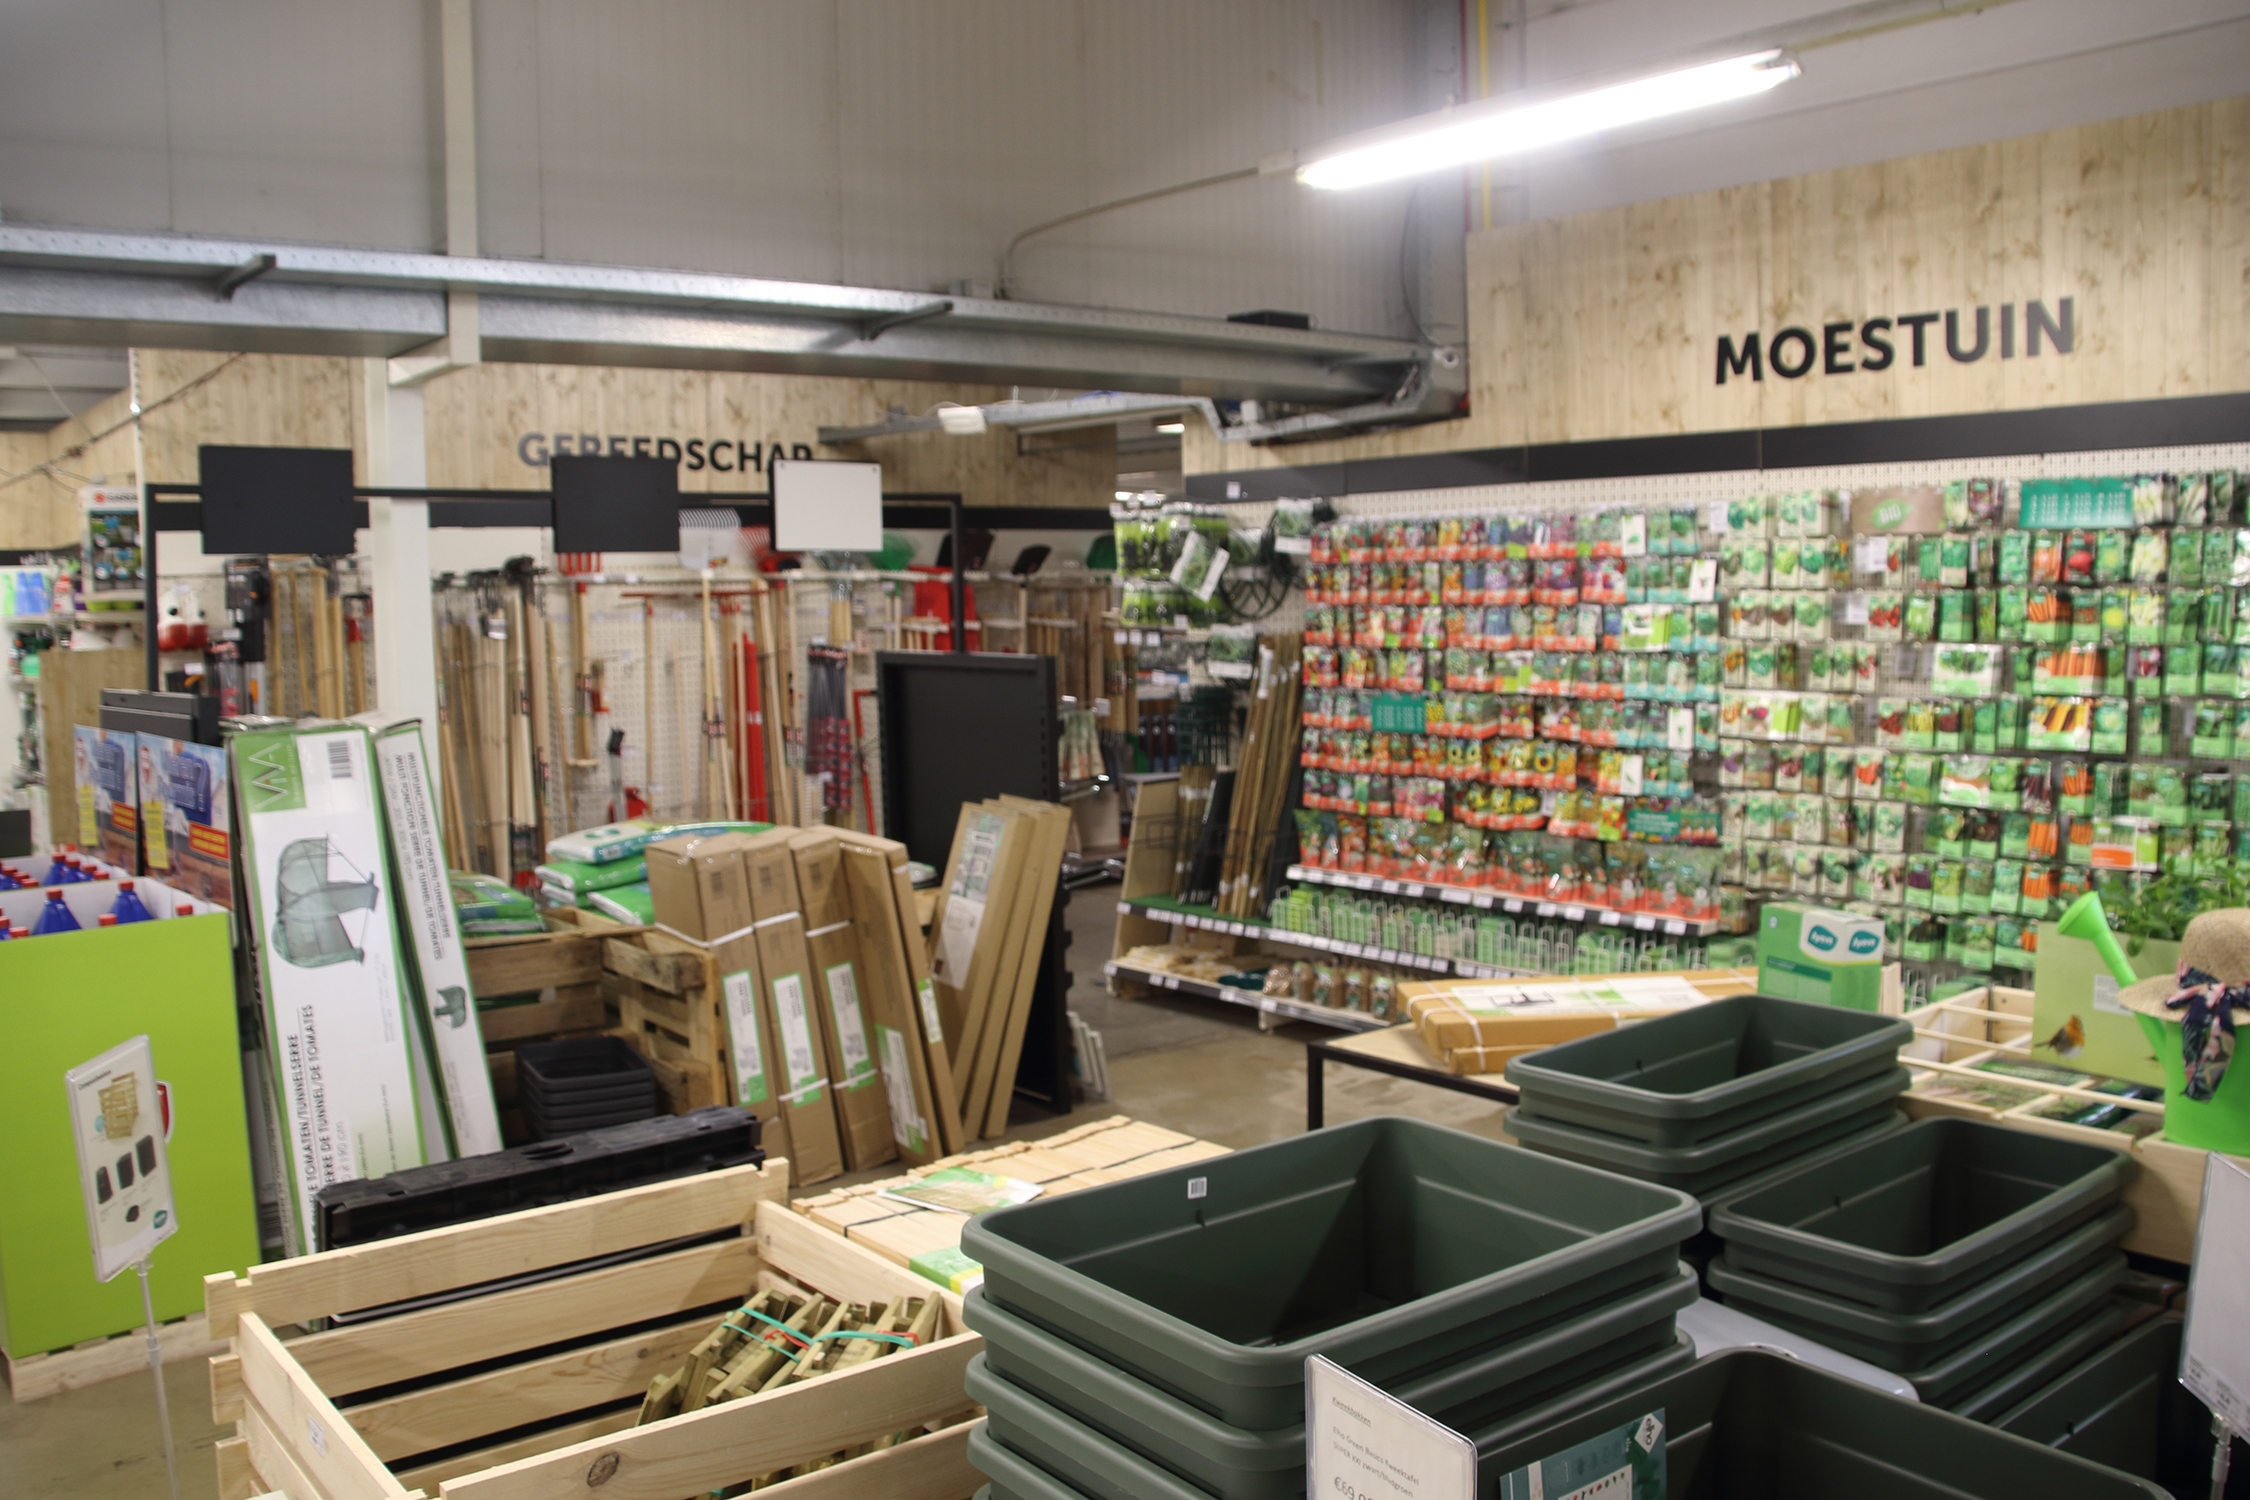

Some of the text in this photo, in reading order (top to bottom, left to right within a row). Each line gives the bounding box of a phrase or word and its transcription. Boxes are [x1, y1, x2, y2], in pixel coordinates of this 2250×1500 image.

[1716, 297, 2075, 386] MOESTUIN
[301, 1004, 319, 1061] TOMATES
[318, 1135, 332, 1151] DE
[323, 1154, 336, 1183] ERRE
[1346, 1435, 1364, 1452] Green
